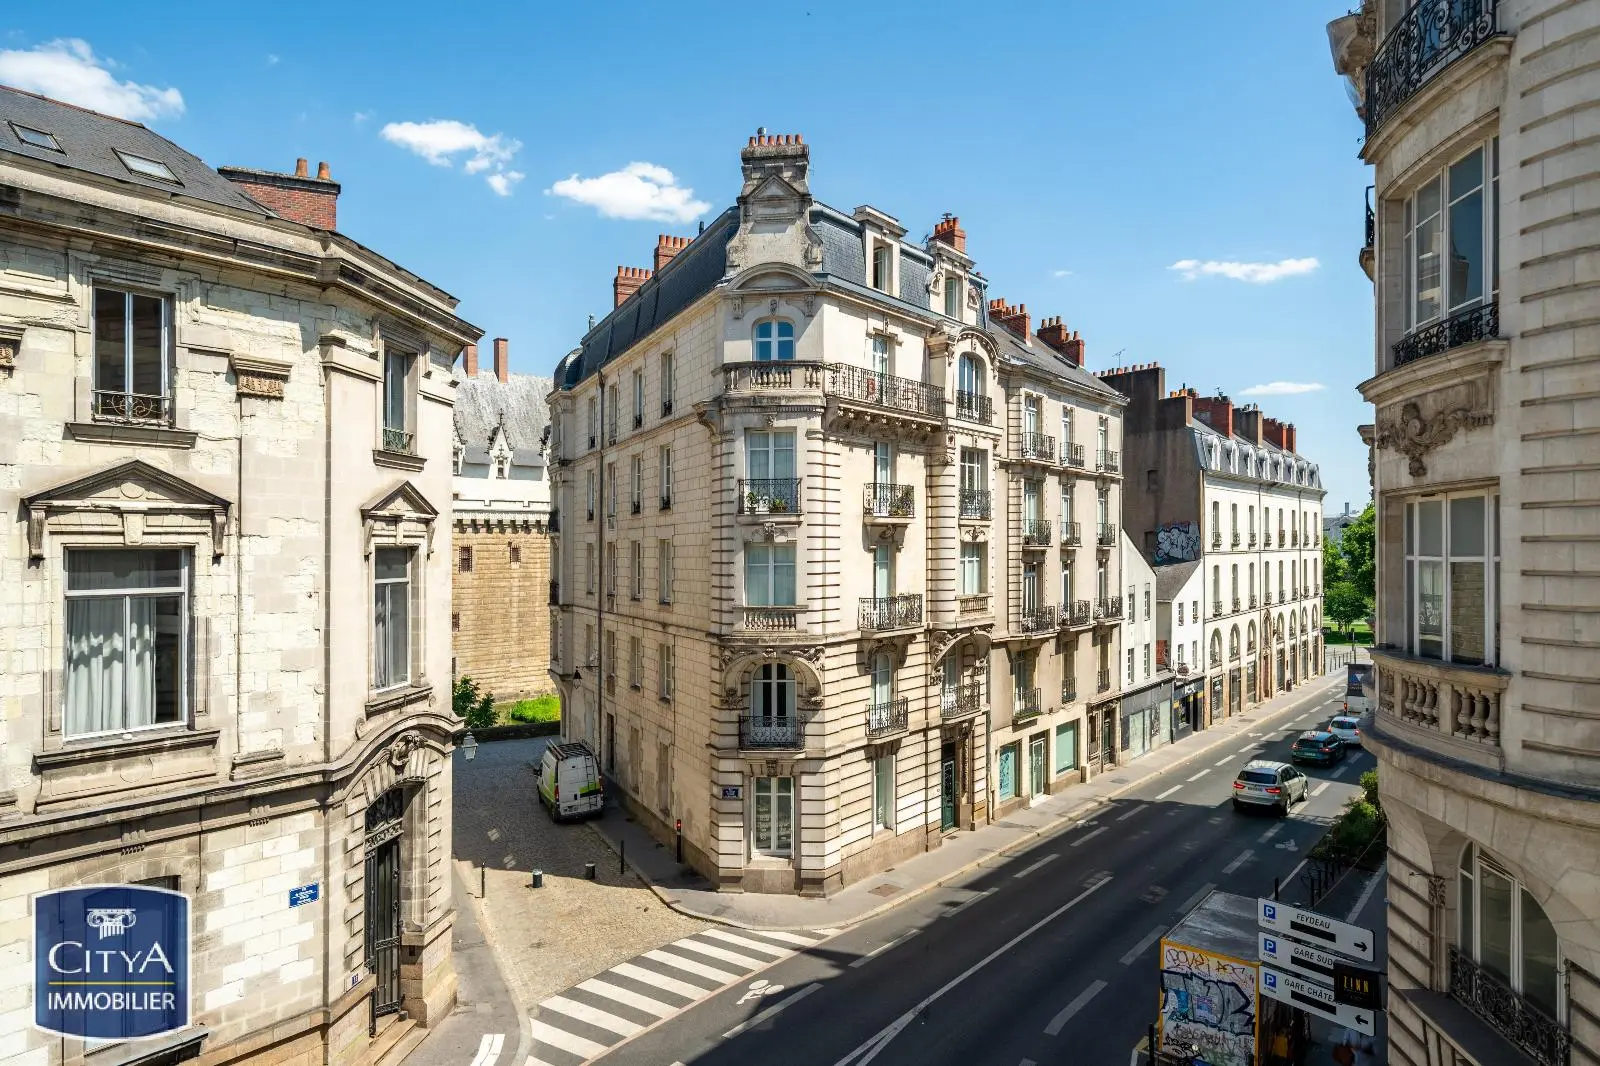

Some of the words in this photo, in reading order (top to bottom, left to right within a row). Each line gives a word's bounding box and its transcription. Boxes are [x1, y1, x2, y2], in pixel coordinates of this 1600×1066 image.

[1296, 913, 1331, 930] FEYDEAU
[1293, 947, 1315, 960] GARE
[1316, 953, 1334, 967] SUD
[1284, 978, 1306, 993] GARE
[1307, 986, 1342, 1005] CHÂTE
[1343, 975, 1369, 993] ZINN
